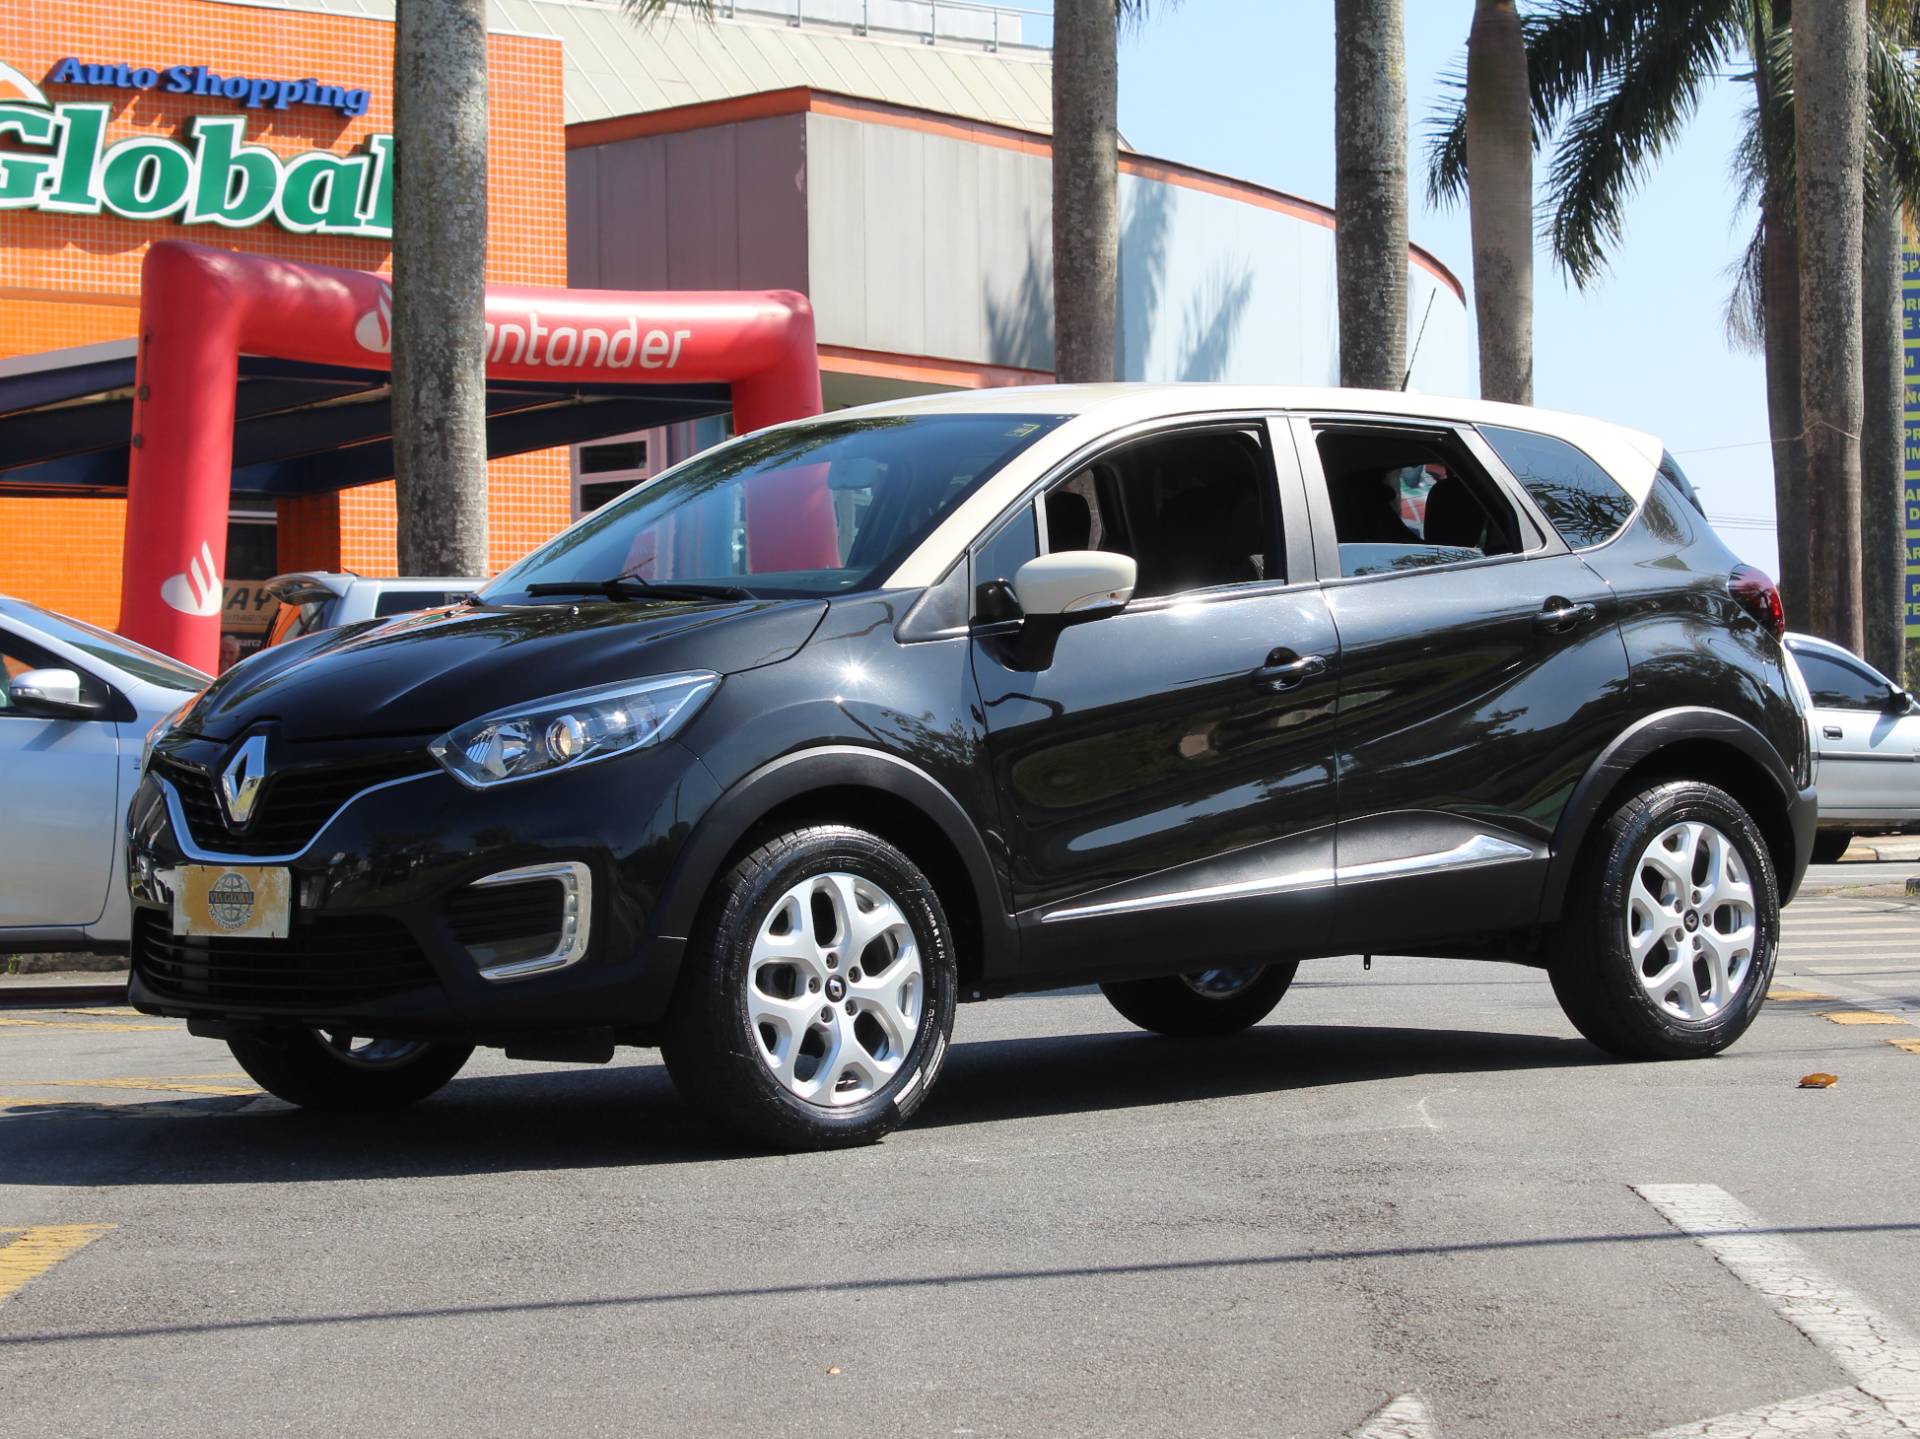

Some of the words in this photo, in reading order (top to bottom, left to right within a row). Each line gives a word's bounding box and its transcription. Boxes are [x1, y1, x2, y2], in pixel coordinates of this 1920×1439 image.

[53, 57, 158, 90] Auto
[163, 64, 371, 117] Shopping
[485, 312, 691, 369] ntander
